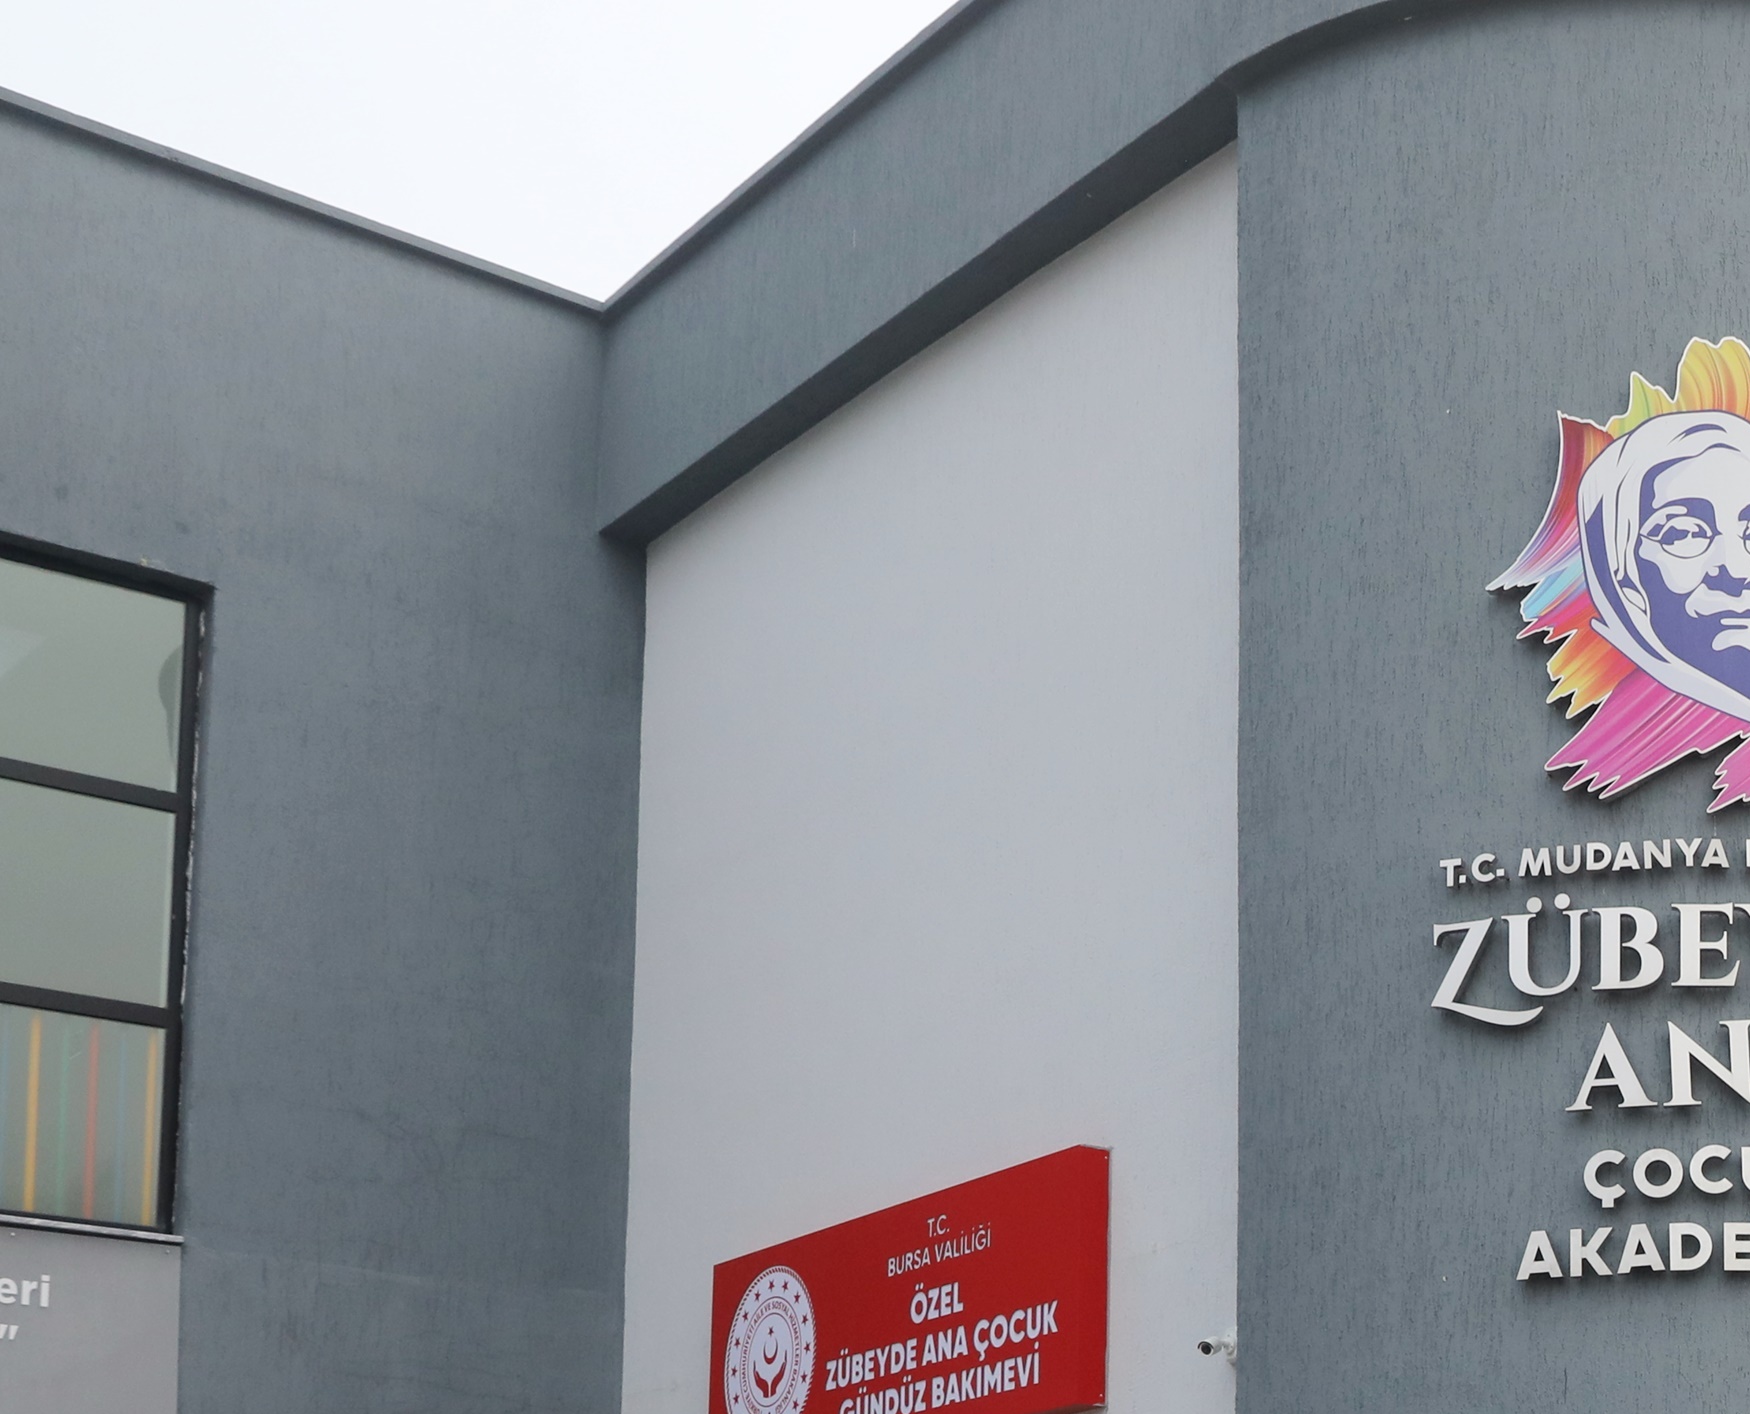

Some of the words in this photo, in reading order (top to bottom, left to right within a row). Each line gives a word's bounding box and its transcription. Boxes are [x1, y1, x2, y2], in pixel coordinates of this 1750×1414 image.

[1439, 851, 1505, 887] T.C.
[1518, 838, 1730, 878] MUDANYA
[887, 1247, 931, 1277] BURSA
[934, 1222, 991, 1262] VALİLİĞİ
[927, 1214, 950, 1237] T.C.
[910, 1282, 964, 1324] ÖZEL
[825, 1338, 918, 1391] ZÜBEYDE
[921, 1325, 968, 1366] ANA
[973, 1300, 1058, 1361] ÇOCUK
[931, 1341, 1040, 1408] BAKIMEVİ
